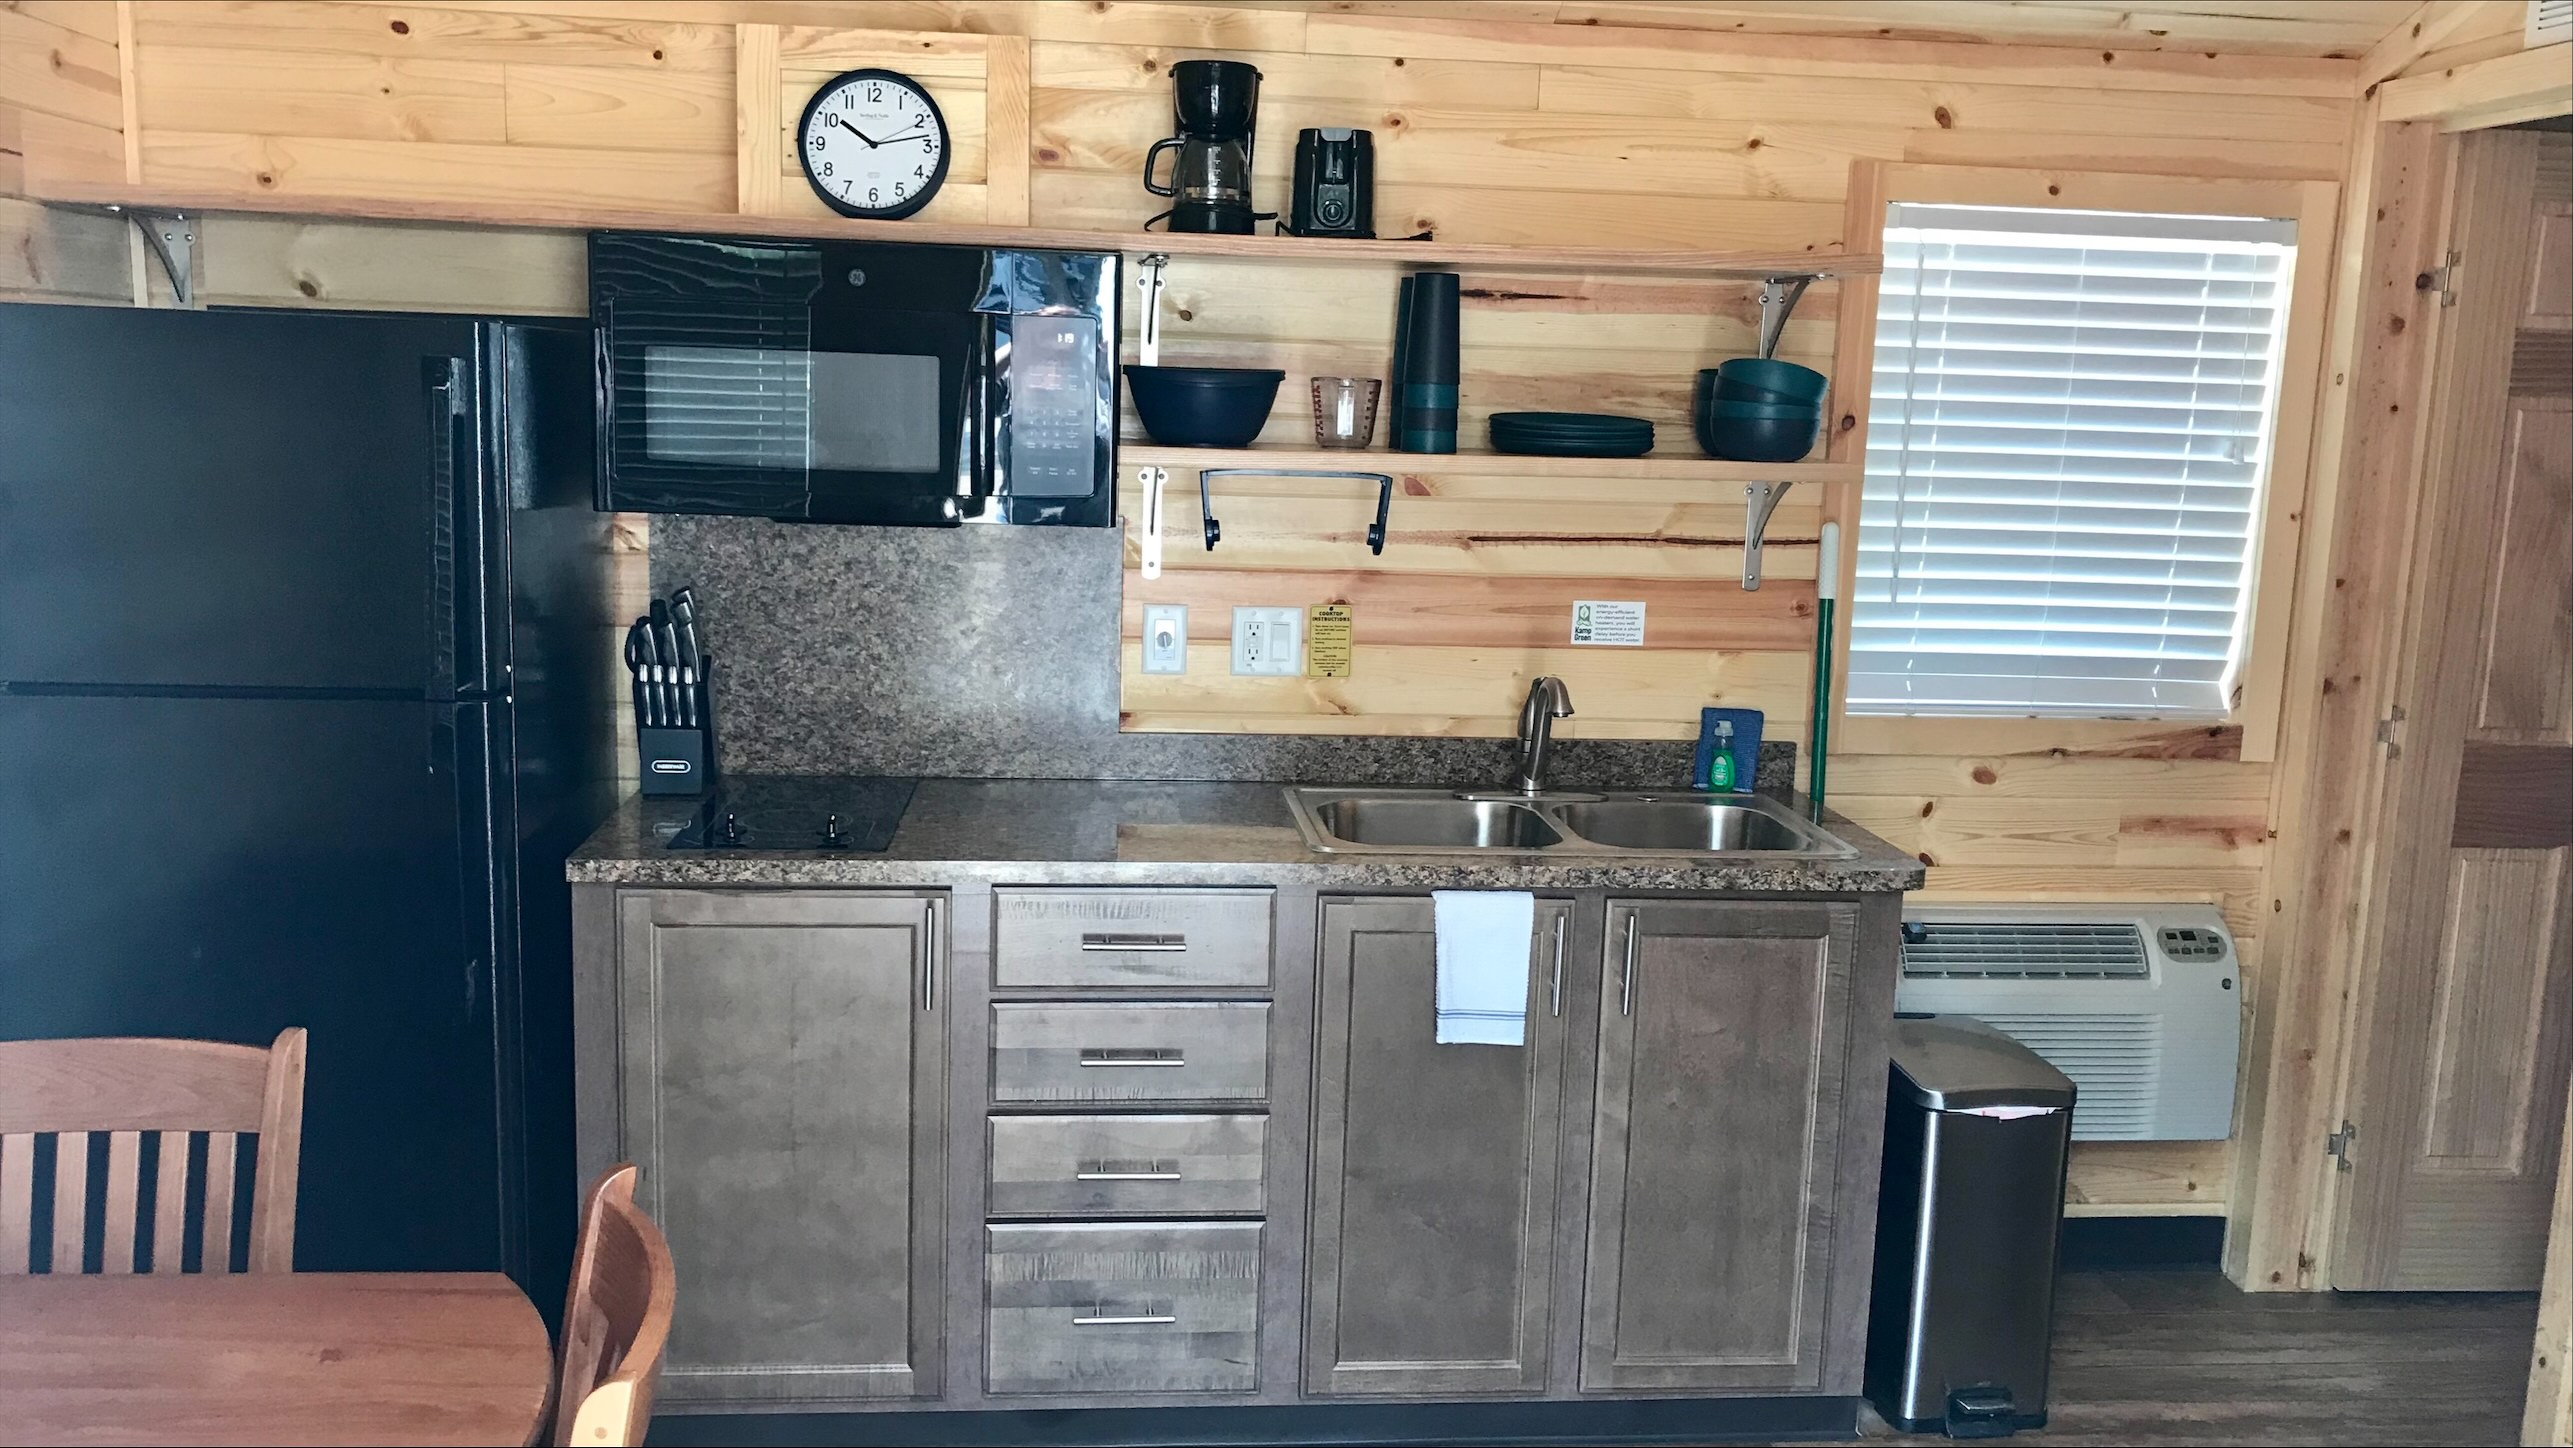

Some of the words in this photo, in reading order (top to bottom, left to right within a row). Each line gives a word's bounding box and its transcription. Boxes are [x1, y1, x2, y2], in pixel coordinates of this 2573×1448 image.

[845, 94, 854, 110] 11
[867, 87, 882, 103] 12
[898, 95, 903, 110] 1
[824, 112, 839, 128] 10
[914, 113, 925, 128] 2
[816, 136, 826, 151] 9
[923, 139, 933, 154] 3
[823, 162, 833, 177] 8
[913, 164, 924, 179] 4
[843, 180, 853, 195] 7
[868, 187, 879, 202] 6
[895, 182, 905, 197] 5
[1574, 626, 1592, 634] Kamp
